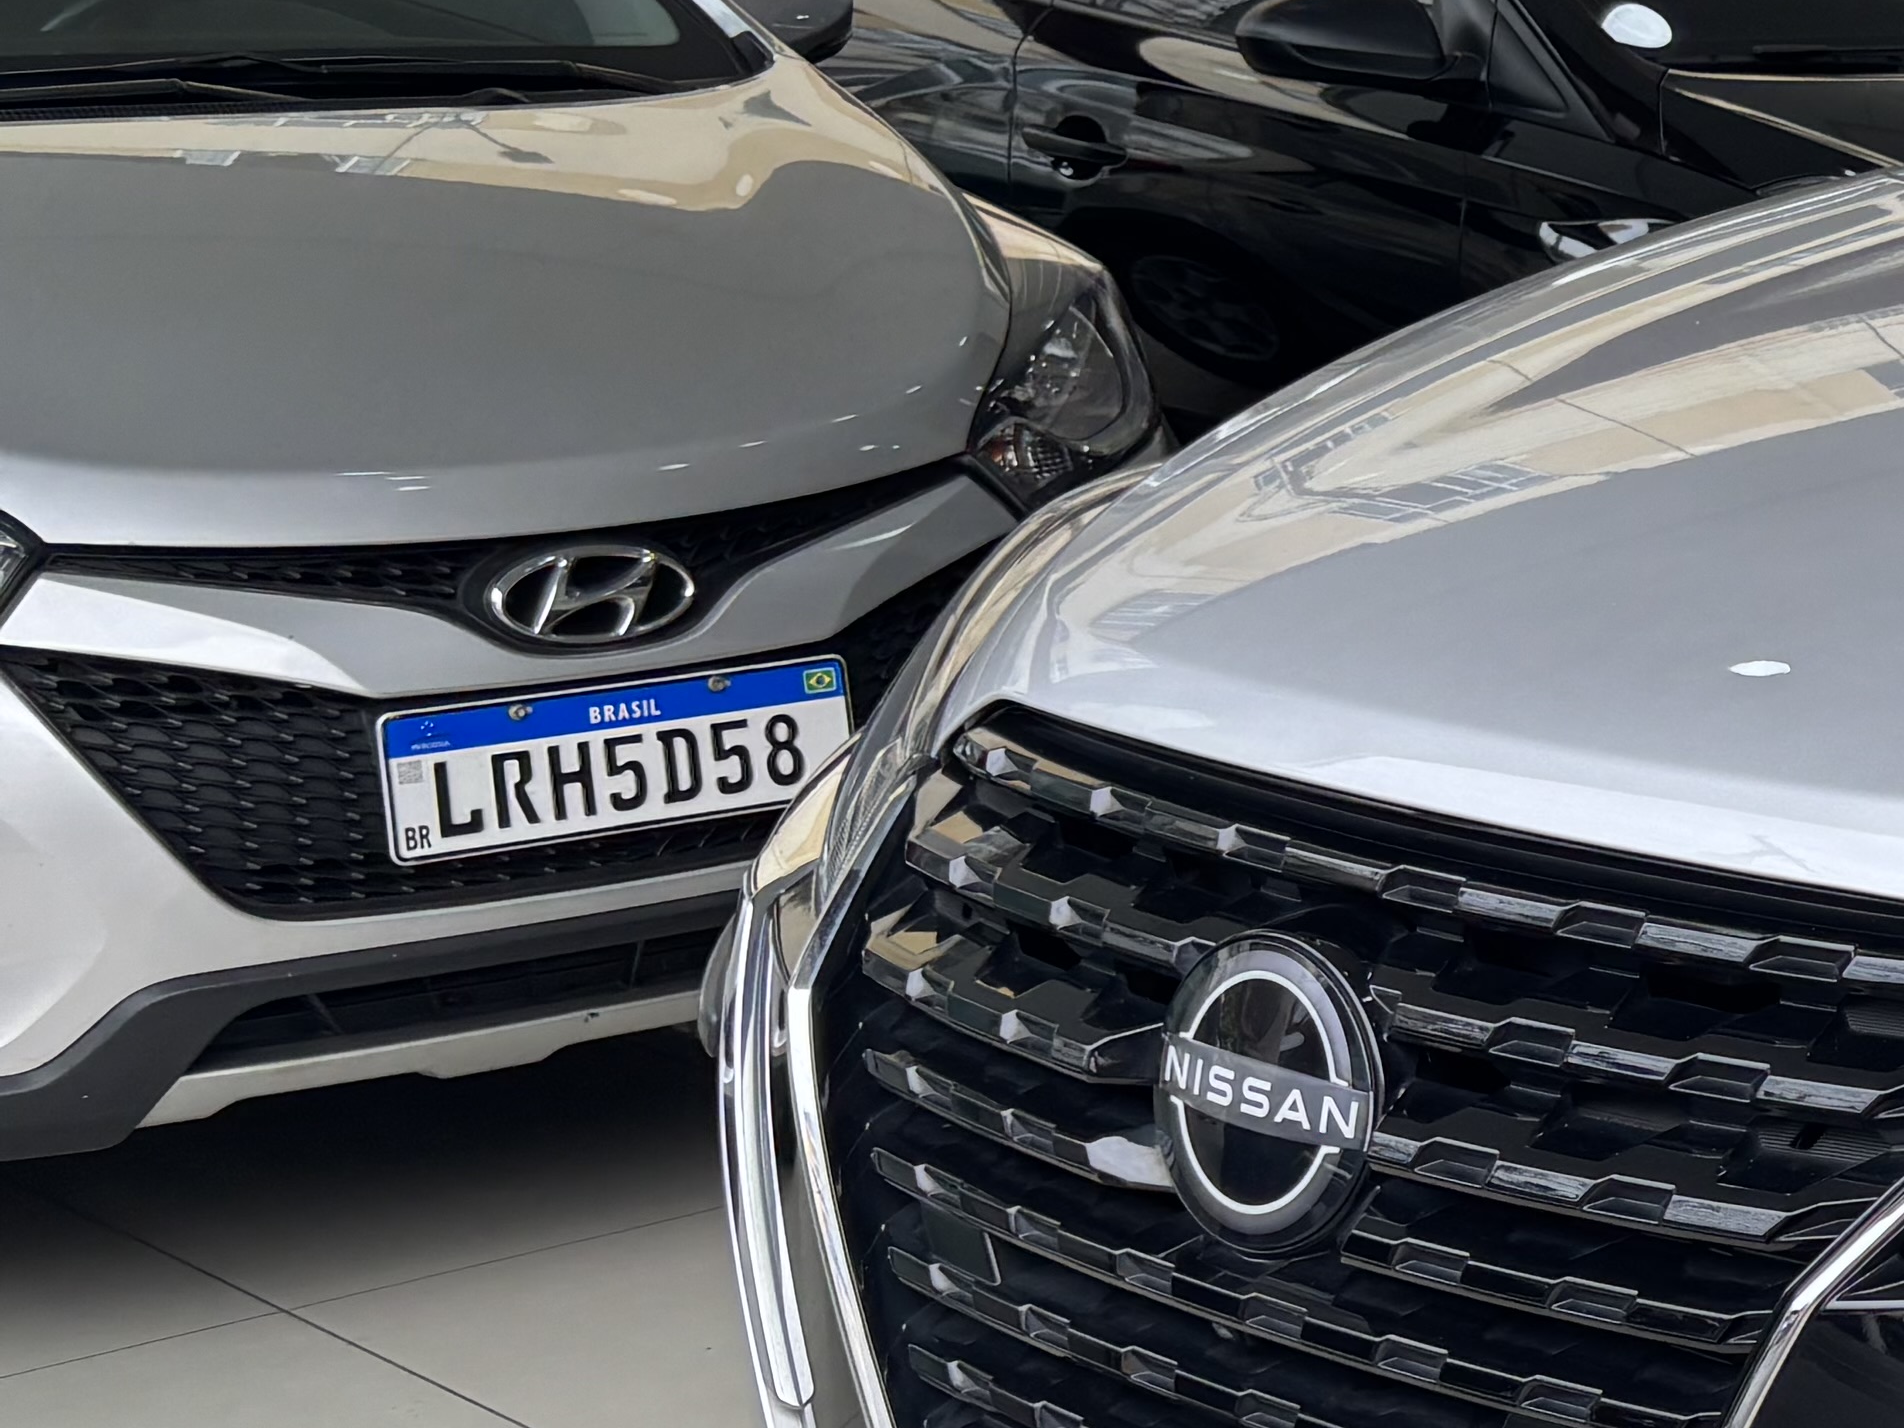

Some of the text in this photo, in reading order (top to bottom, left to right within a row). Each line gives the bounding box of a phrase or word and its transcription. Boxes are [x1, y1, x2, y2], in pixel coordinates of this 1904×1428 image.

[588, 698, 662, 725] BRASIL
[433, 713, 805, 839] LRH5D58
[404, 825, 432, 852] BR
[1163, 1044, 1360, 1139] NISSAN
